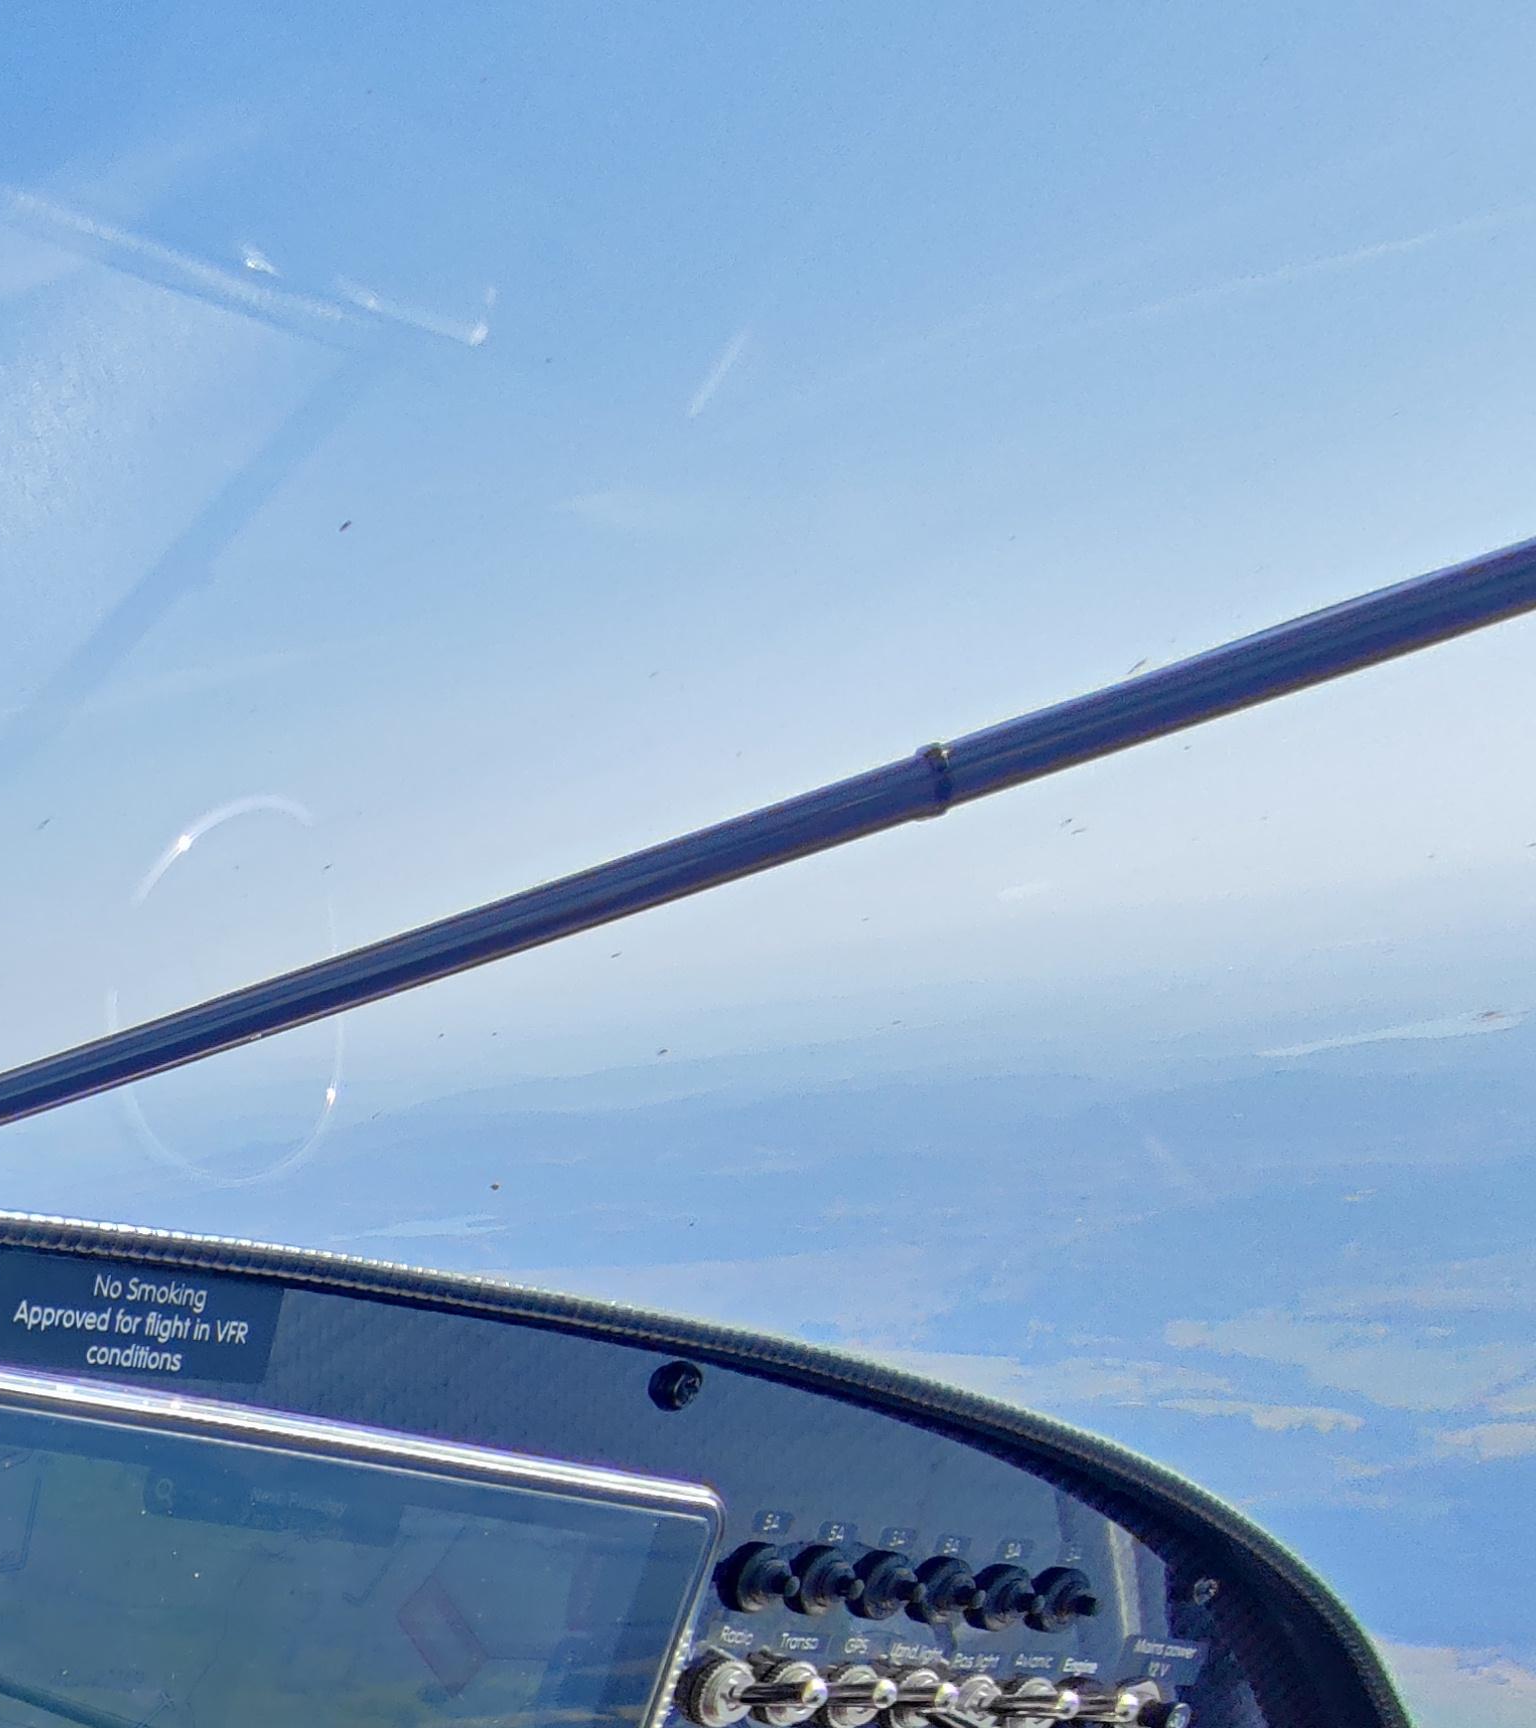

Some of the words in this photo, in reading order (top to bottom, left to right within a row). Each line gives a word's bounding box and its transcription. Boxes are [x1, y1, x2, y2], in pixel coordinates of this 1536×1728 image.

[94, 1274, 122, 1298] No
[126, 1278, 207, 1313] Smoking
[13, 1300, 111, 1331] Approved
[115, 1308, 141, 1334] for
[144, 1312, 190, 1342] flight
[194, 1320, 209, 1340] in
[216, 1320, 248, 1344] VFR
[86, 1344, 182, 1371] conditions
